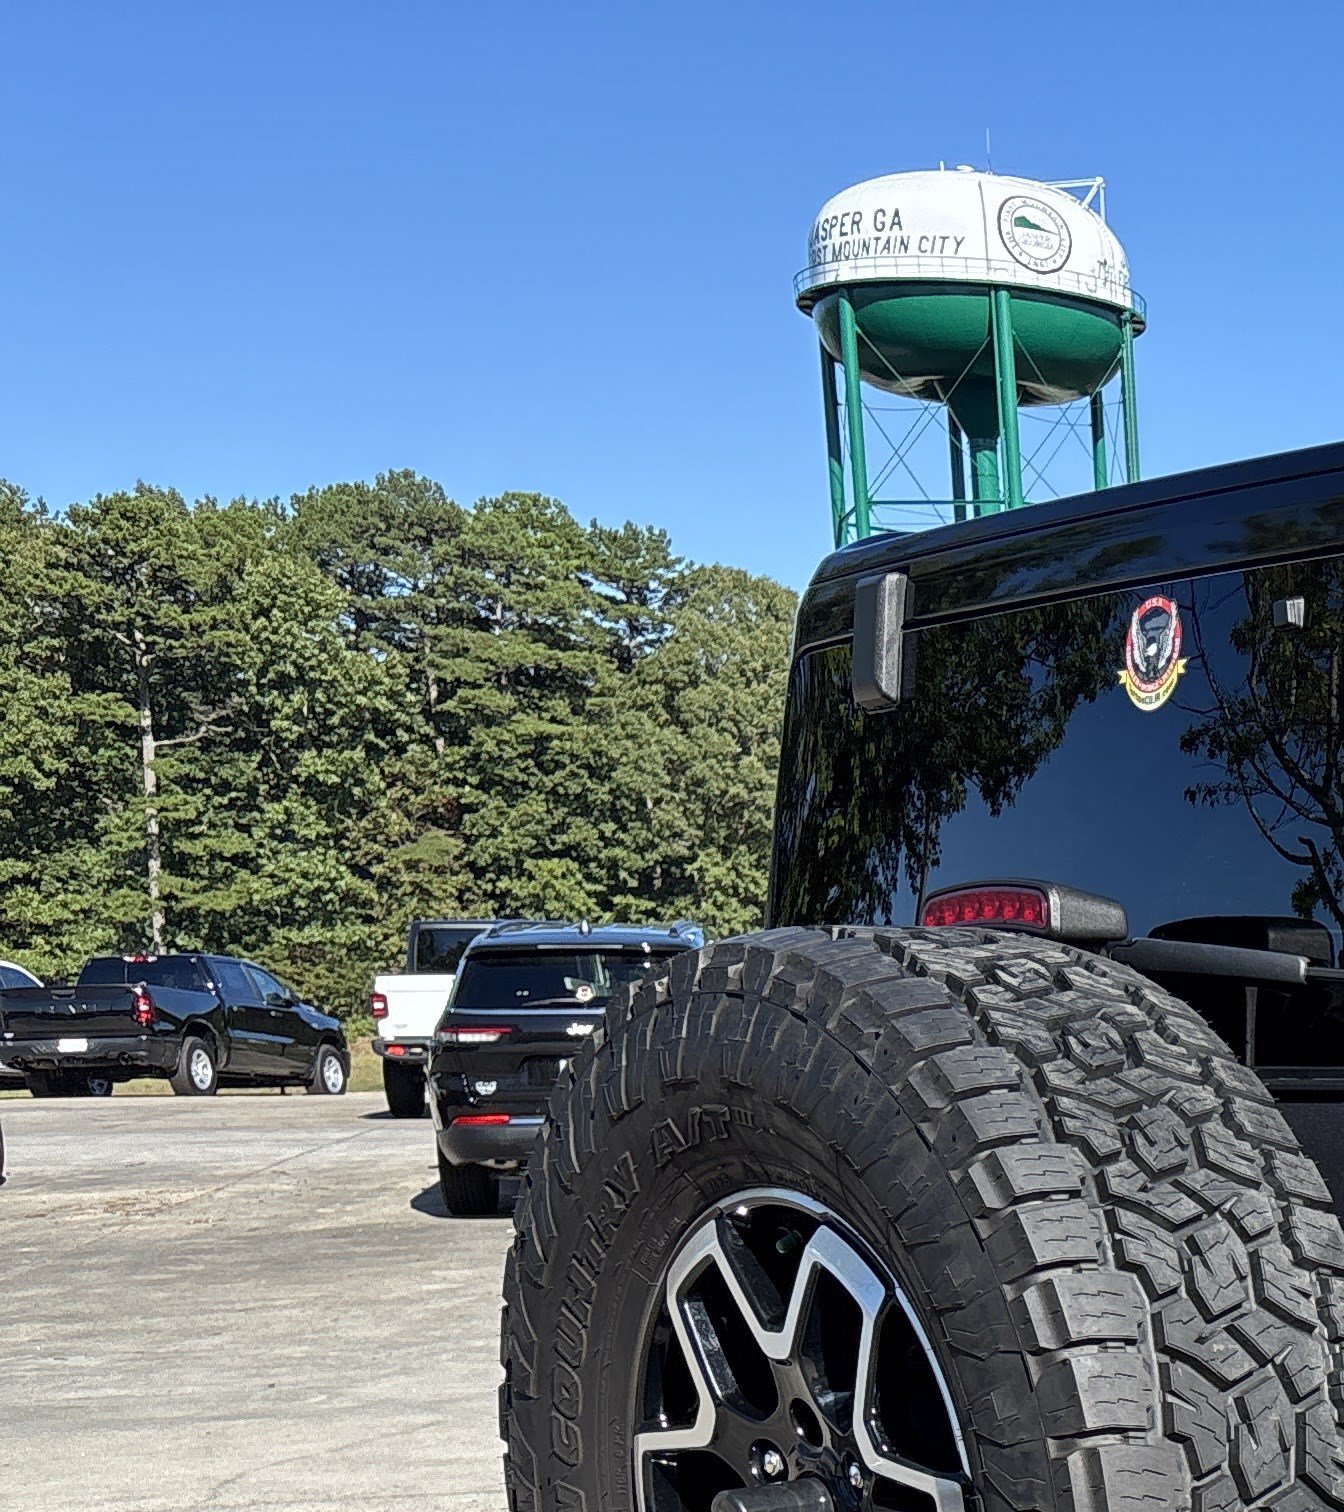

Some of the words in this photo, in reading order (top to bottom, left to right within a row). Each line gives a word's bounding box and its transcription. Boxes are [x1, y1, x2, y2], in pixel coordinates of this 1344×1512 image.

[873, 208, 903, 232] GA
[832, 235, 910, 262] MOUNTAIN
[918, 235, 966, 255] CITY
[649, 1102, 731, 1169] A/T
